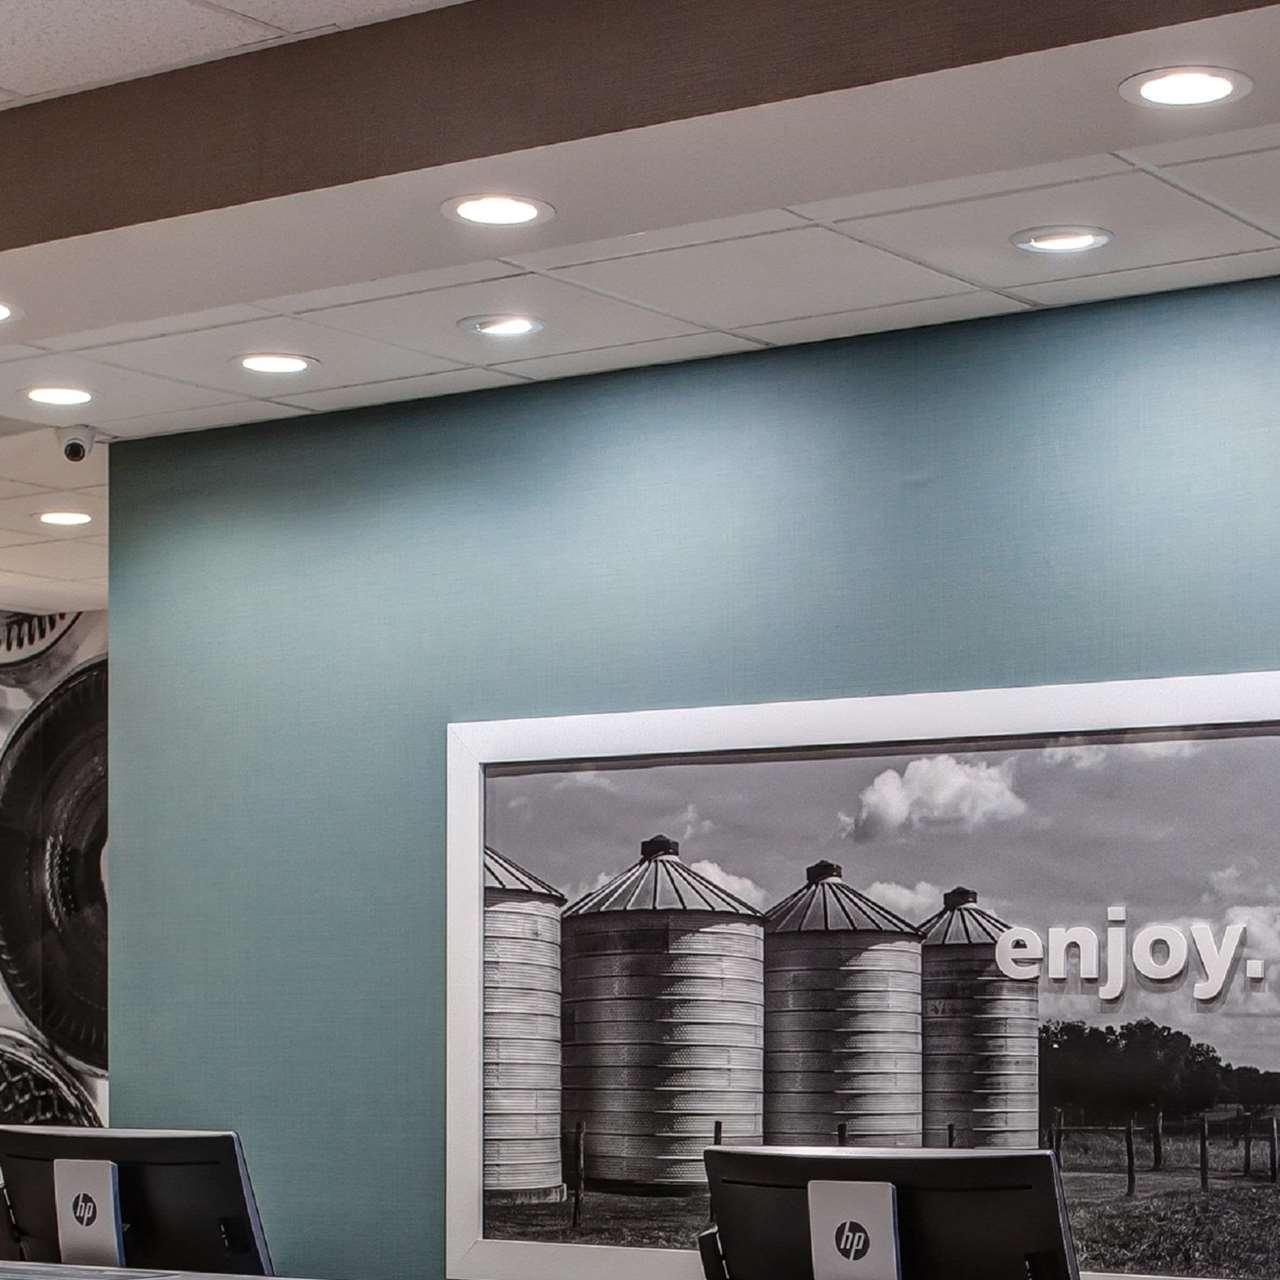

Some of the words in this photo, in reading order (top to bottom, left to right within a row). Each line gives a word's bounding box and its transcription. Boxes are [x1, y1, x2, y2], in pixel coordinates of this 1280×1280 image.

[995, 905, 1265, 1000] enjoy.
[75, 1193, 94, 1227] hp
[839, 1221, 866, 1261] hp
